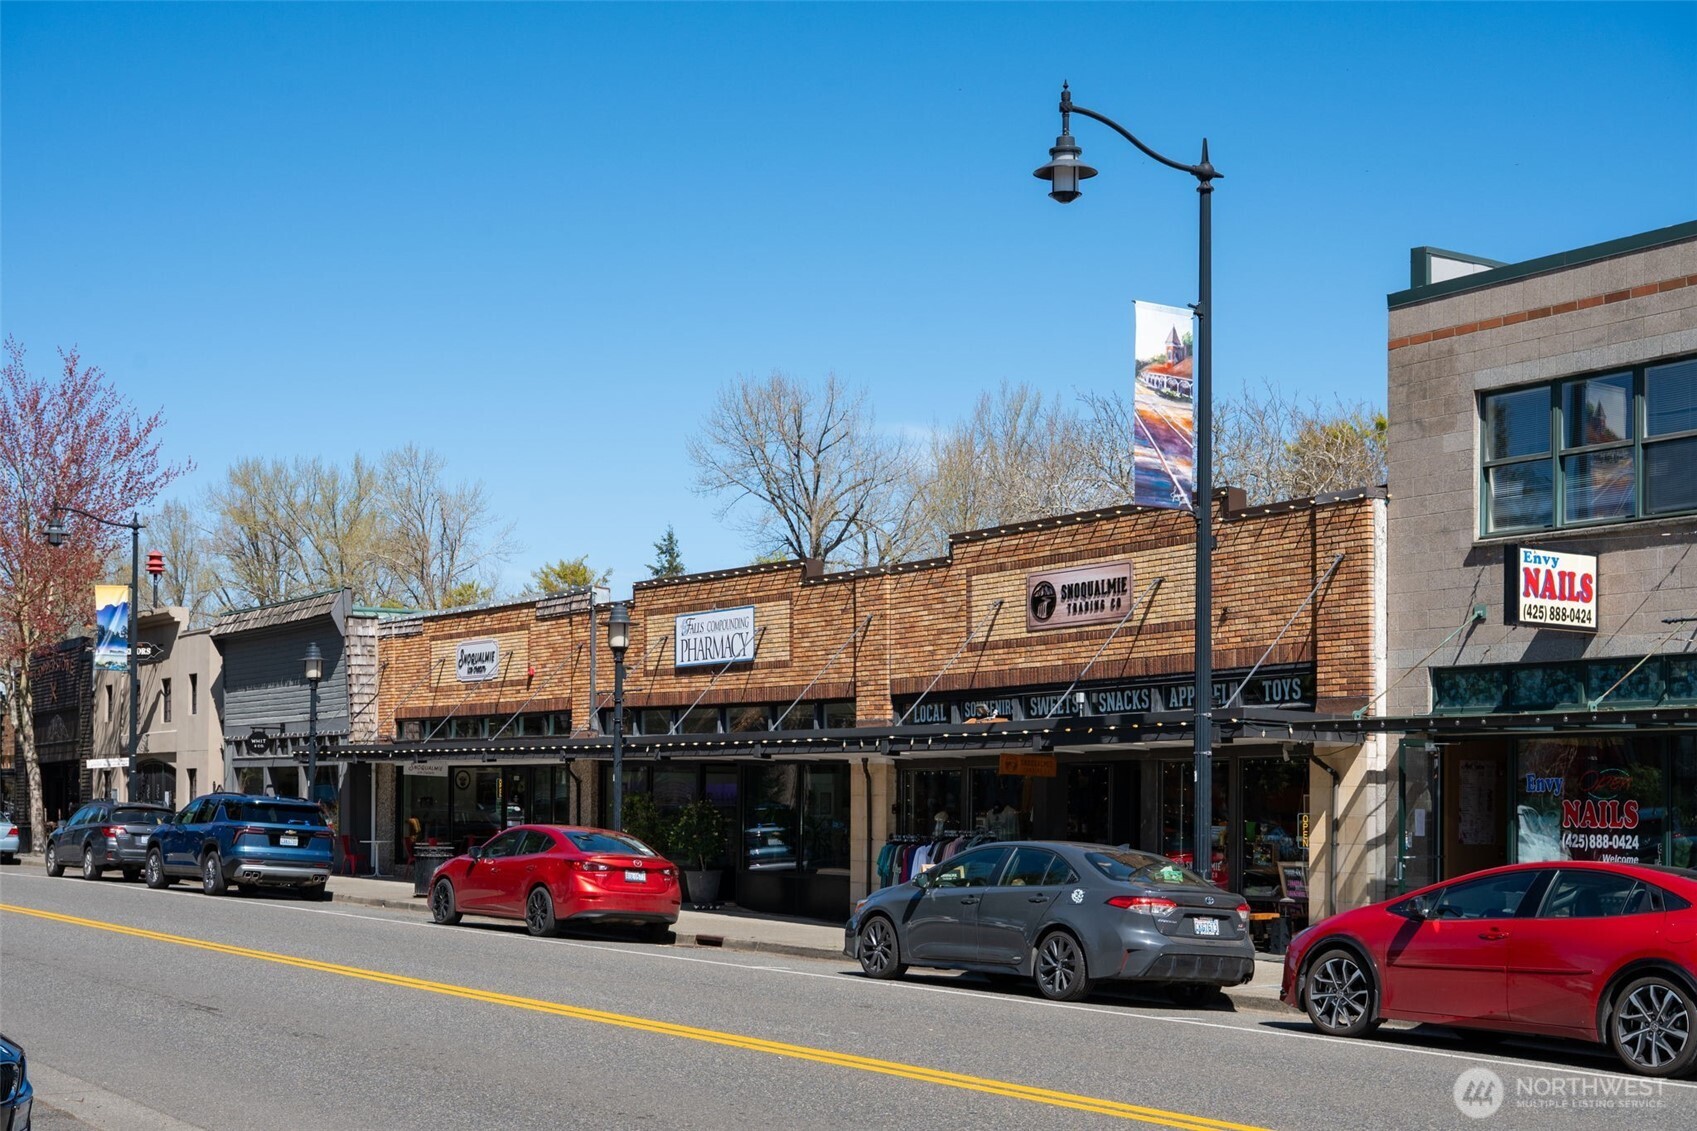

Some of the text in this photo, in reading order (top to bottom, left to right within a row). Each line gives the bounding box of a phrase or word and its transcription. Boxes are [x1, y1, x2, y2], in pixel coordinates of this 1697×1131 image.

[1523, 550, 1559, 568] Envy
[1061, 576, 1128, 602] SNOQUALMIE
[1522, 567, 1593, 603] NAILS
[1067, 597, 1122, 616] TRADING CO
[1523, 603, 1592, 624] (425) 888-0424
[706, 616, 750, 633] COMPOUNDING
[680, 631, 749, 662] PHARMACY
[913, 703, 947, 723] LOCAL
[1030, 694, 1079, 716] SWEETS
[1099, 688, 1150, 712] SNACKS
[1169, 683, 1228, 708] APPEL
[1262, 678, 1301, 702] TOYS
[1526, 773, 1564, 796] Envy
[1562, 800, 1639, 829] NAILS
[1602, 854, 1639, 864] Welcome
